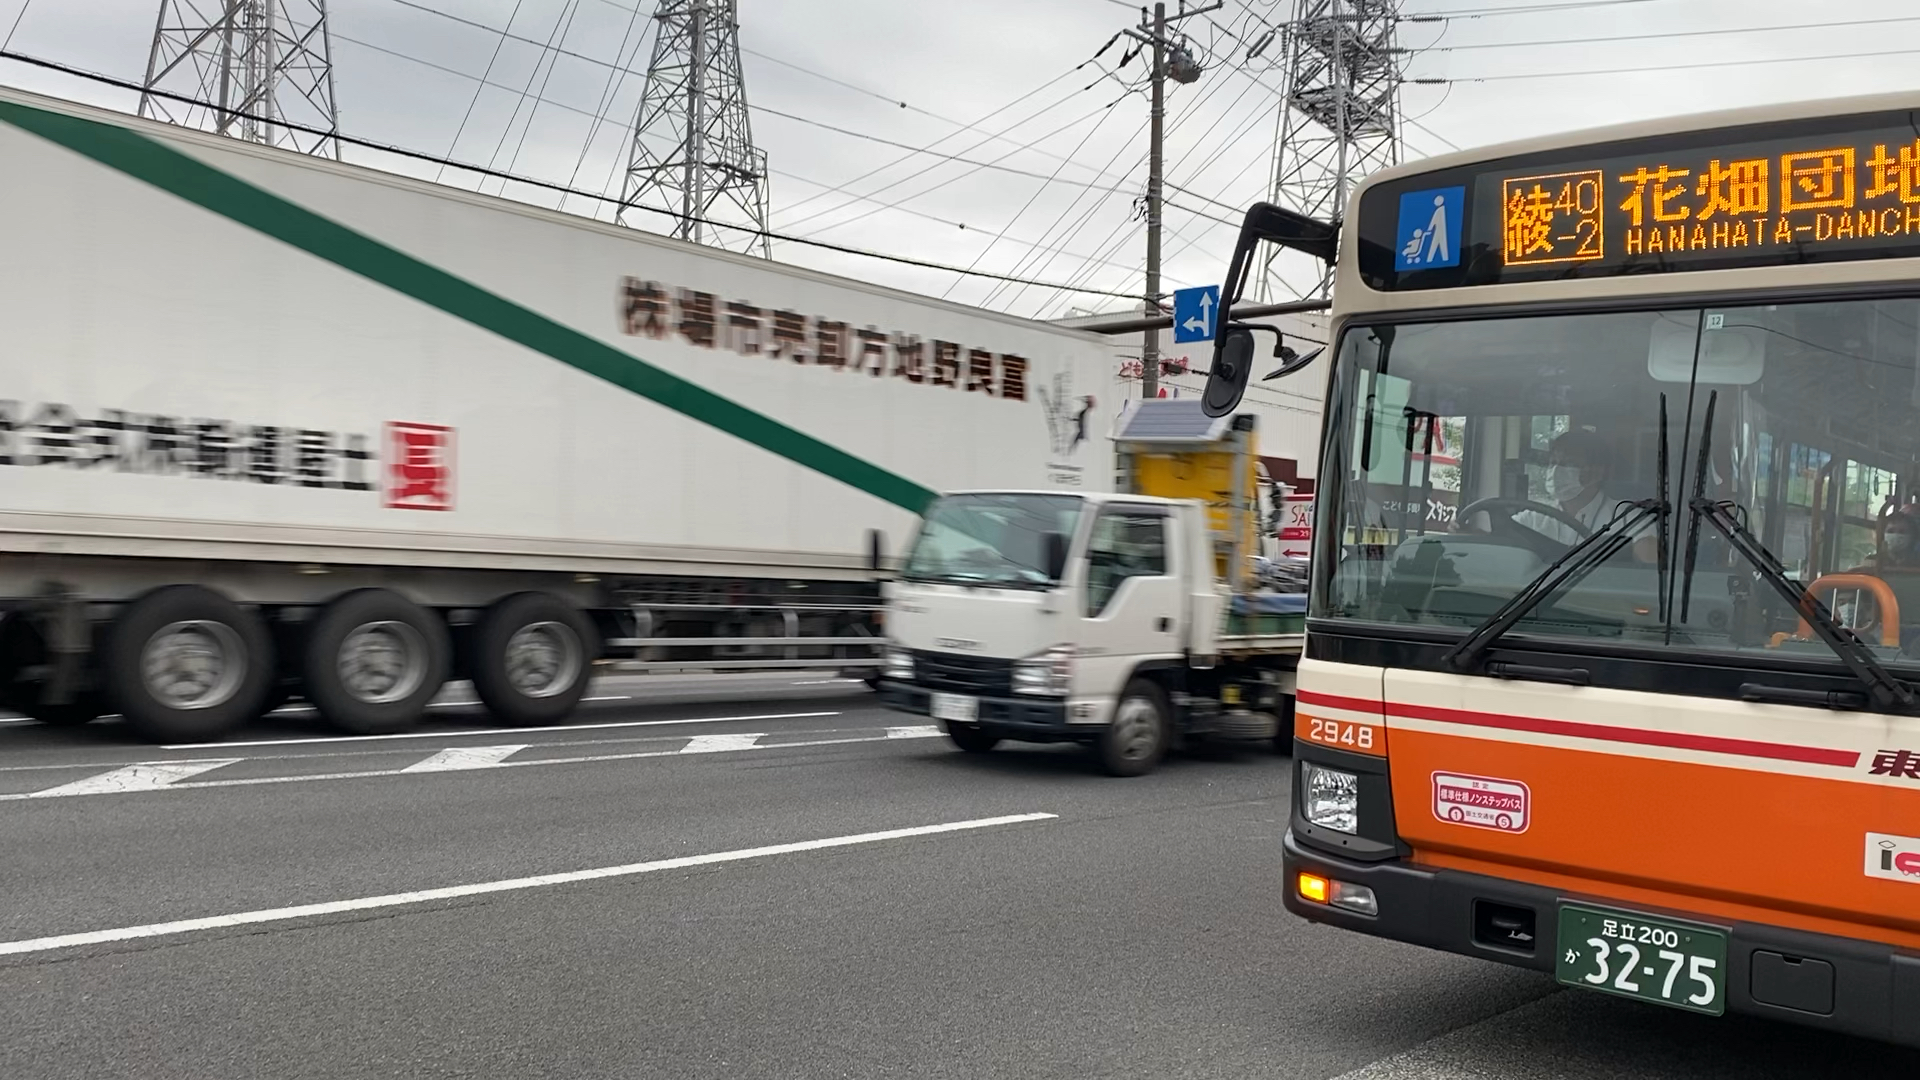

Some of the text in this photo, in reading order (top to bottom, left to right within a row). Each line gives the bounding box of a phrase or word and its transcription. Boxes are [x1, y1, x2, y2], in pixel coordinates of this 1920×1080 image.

[1554, 179, 1598, 216] 40
[1619, 138, 1920, 226] 花畑団地
[1310, 718, 1373, 749] 2948
[1565, 938, 1716, 1005] か 32-75
